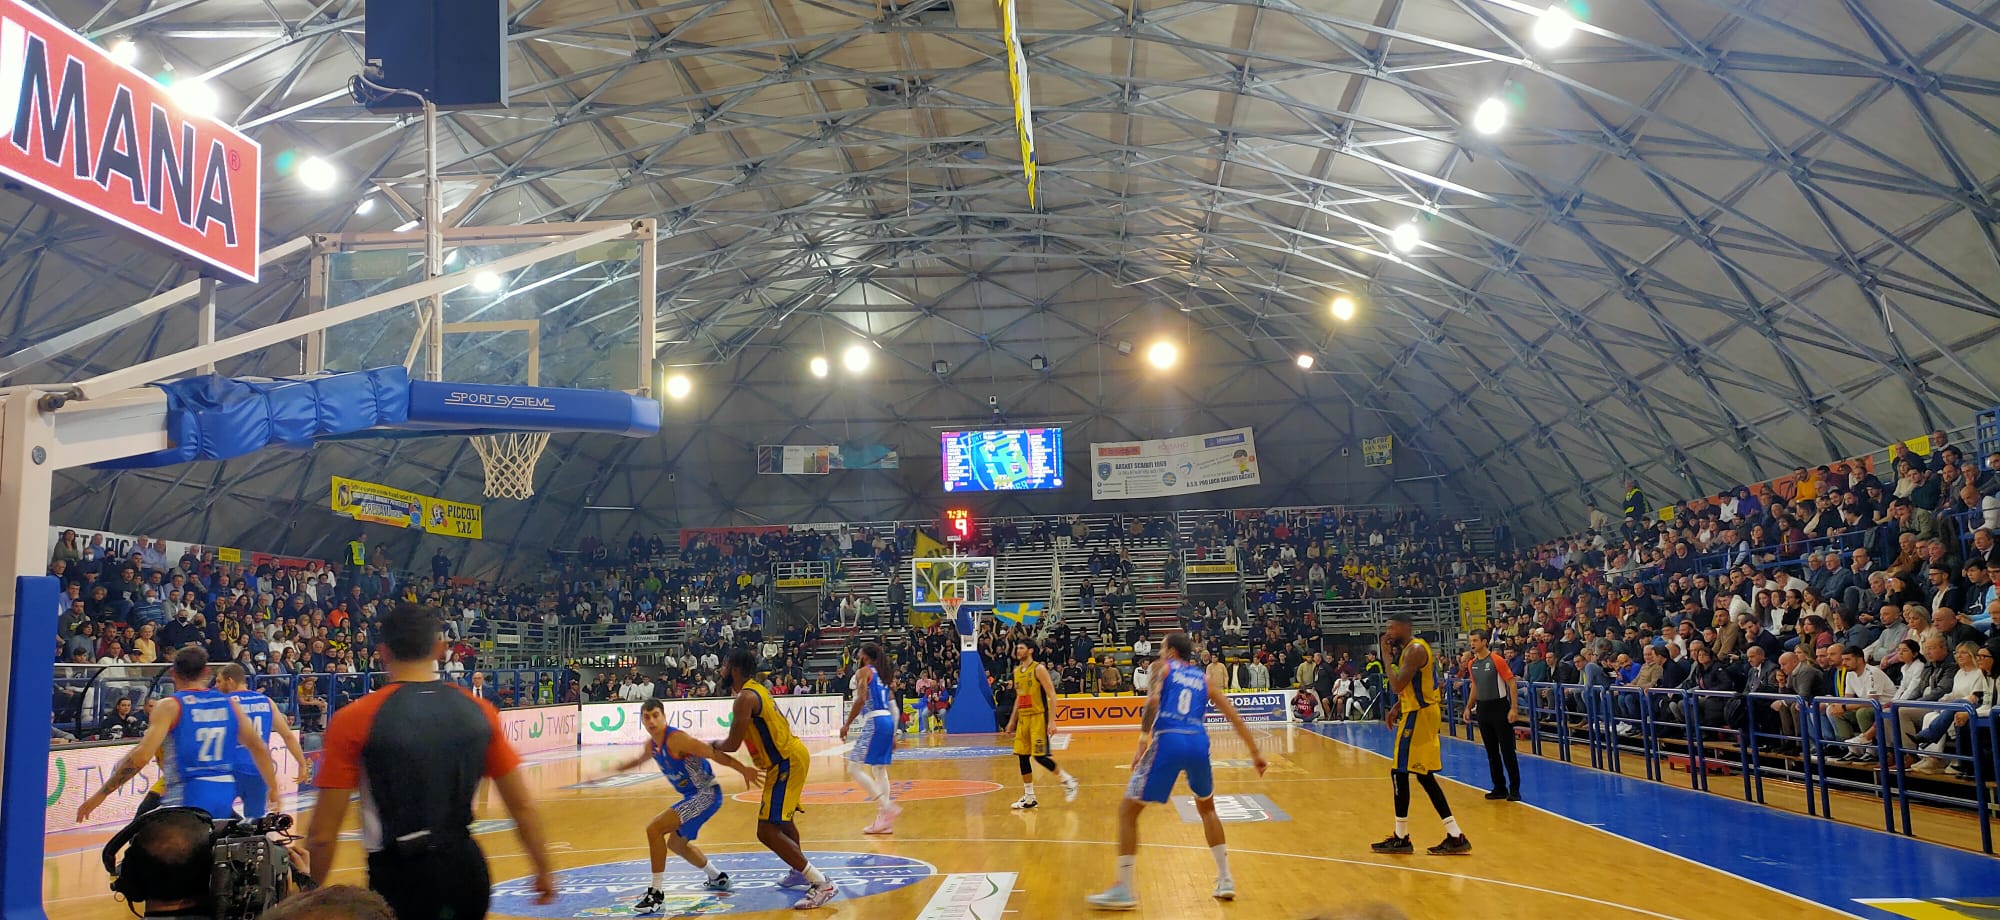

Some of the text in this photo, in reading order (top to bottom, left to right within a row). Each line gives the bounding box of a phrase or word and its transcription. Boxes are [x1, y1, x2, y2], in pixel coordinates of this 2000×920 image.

[448, 391, 549, 408] SPORT SYSTEM
[447, 504, 480, 521] PICCOLI
[946, 509, 968, 519] 7:34
[955, 519, 968, 536] 9
[1206, 695, 1281, 708] OGOBARDI
[633, 709, 709, 730] TIST
[782, 705, 836, 725] WIST
[500, 718, 526, 742] WIST
[546, 714, 576, 737] TWIST
[195, 726, 228, 762] 27
[488, 876, 912, 898] LOGOBARDI
